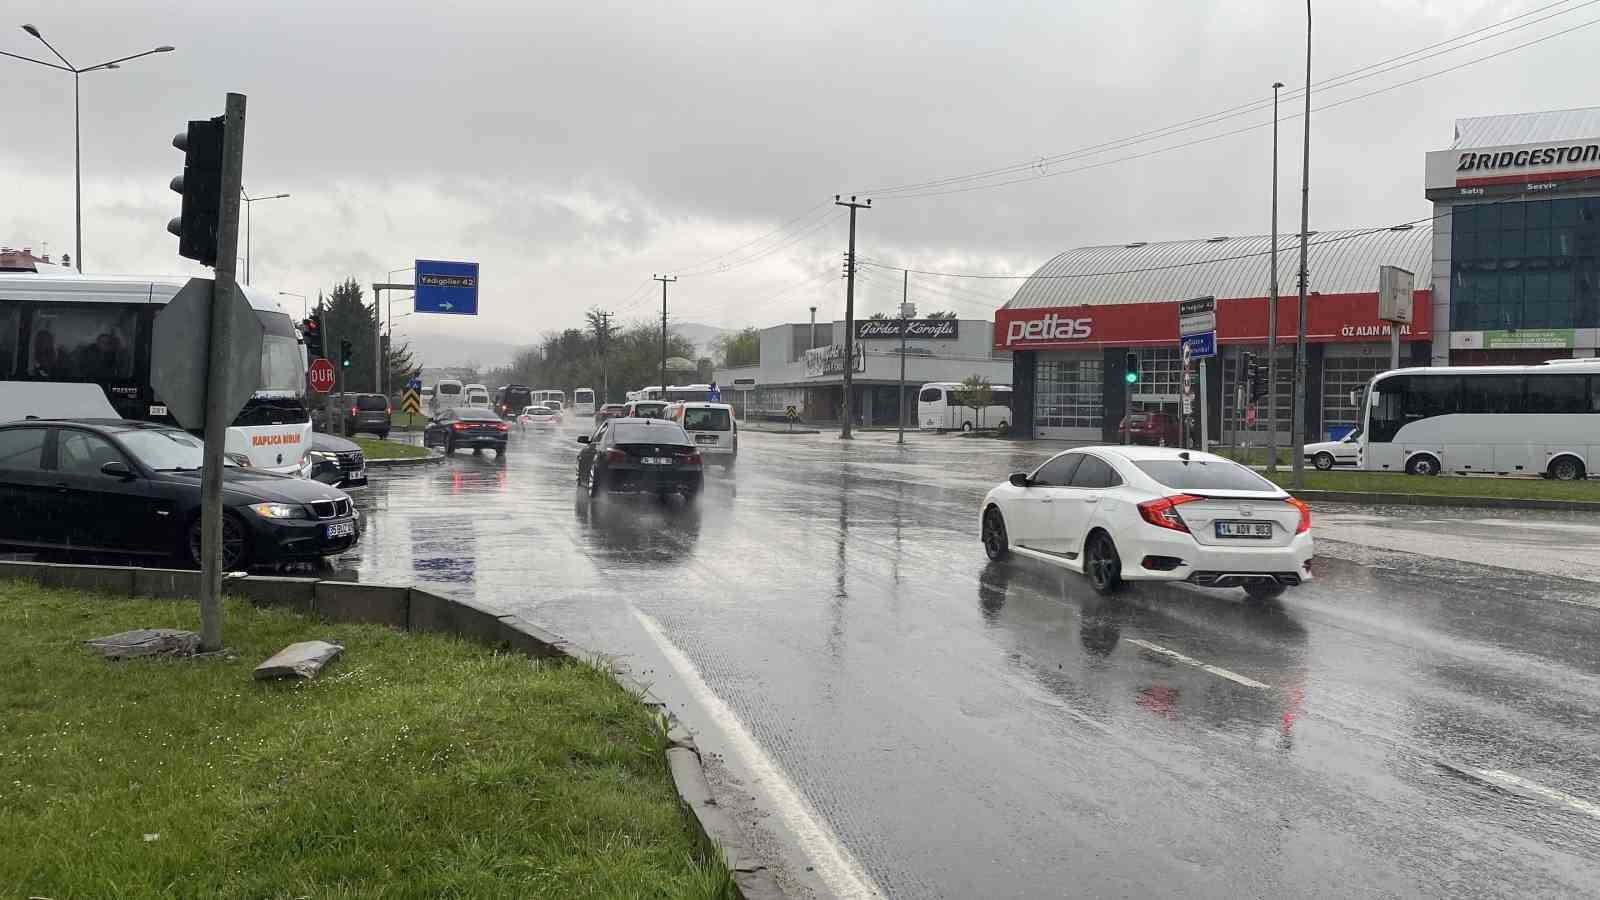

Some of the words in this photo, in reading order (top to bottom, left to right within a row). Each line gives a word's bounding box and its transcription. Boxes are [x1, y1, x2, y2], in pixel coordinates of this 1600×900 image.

[1457, 144, 1600, 171] BRIDGESTON
[860, 322, 900, 338] Garden
[904, 321, 954, 338] Köroğlu
[1006, 313, 1092, 346] petlas
[1356, 326, 1380, 336] ALAN
[1382, 325, 1411, 336] MAL
[311, 369, 334, 382] DUR
